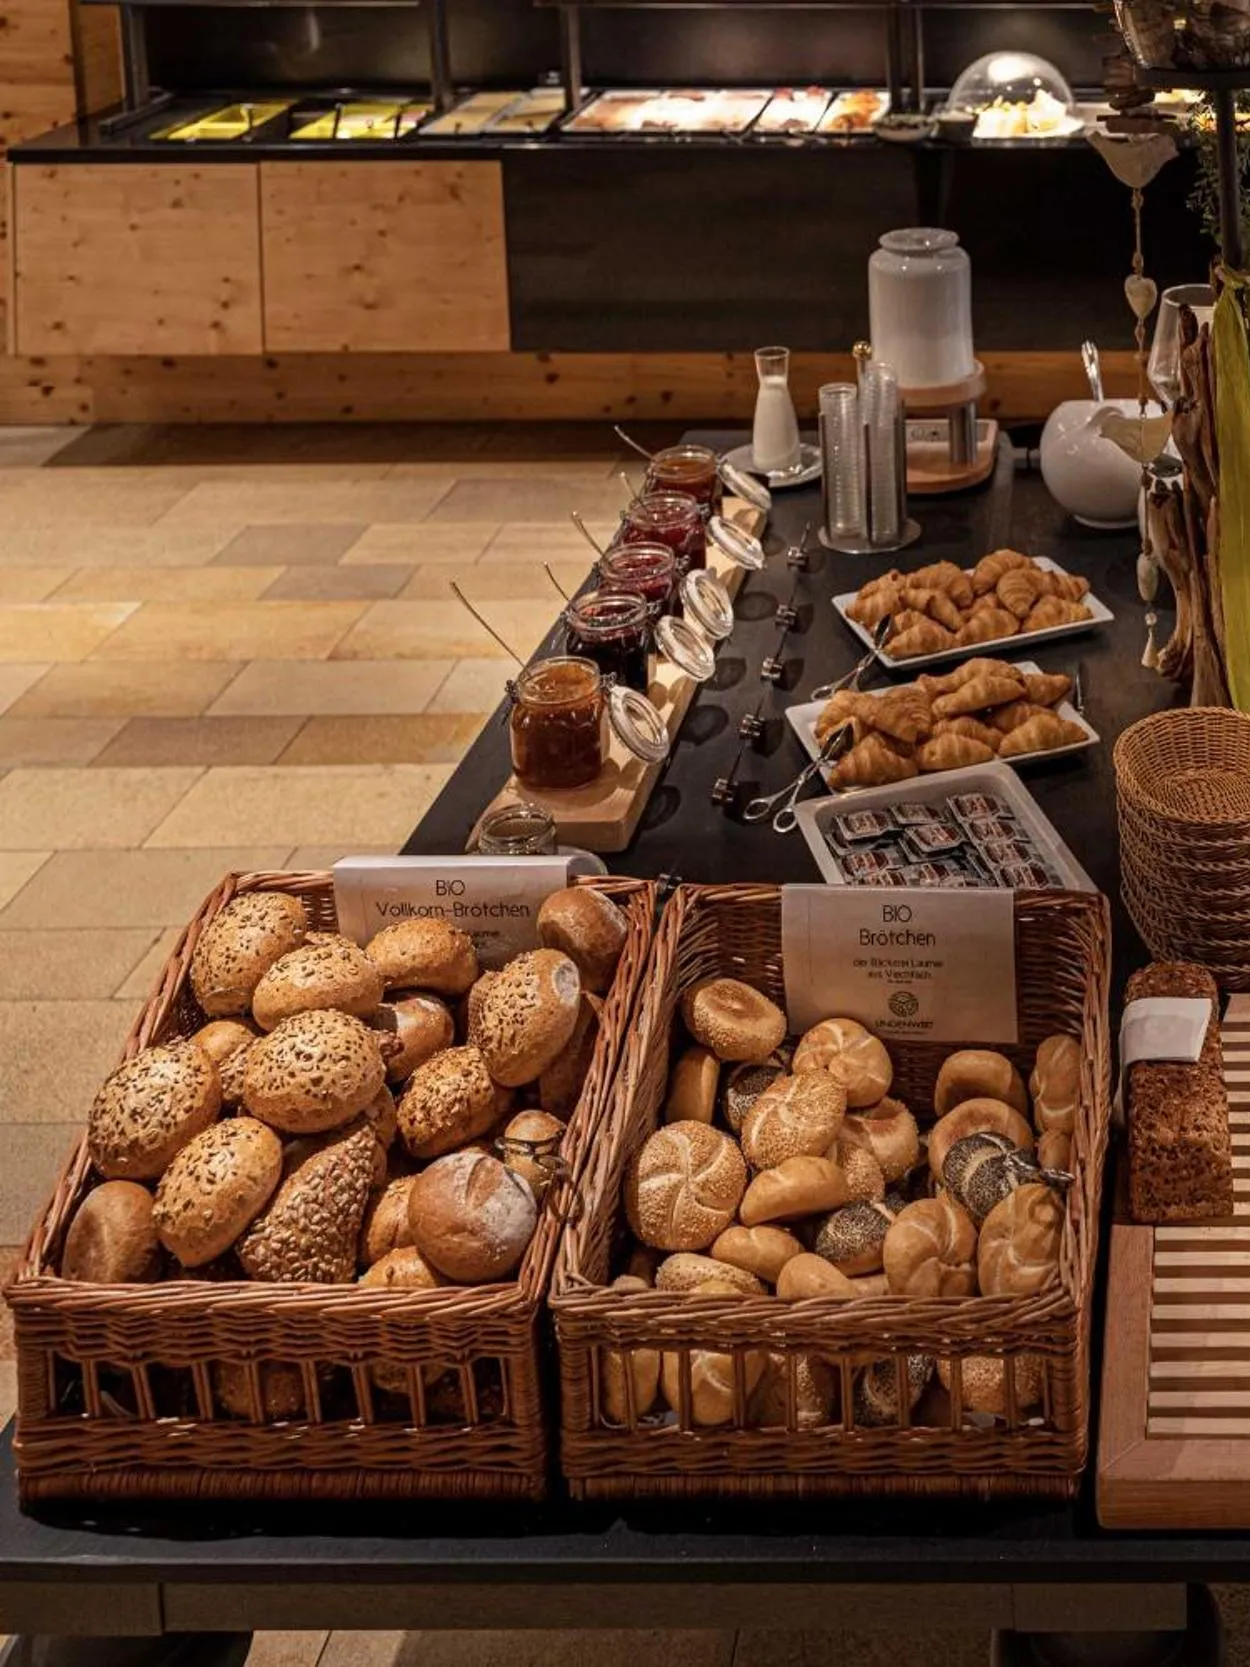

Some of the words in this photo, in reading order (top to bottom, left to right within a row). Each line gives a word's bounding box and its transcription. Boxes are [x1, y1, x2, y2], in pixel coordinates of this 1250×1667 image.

[435, 879, 467, 897] BIO
[376, 901, 530, 918] Vollkorn-Brötchen
[882, 904, 913, 923] BIO
[859, 928, 936, 947] Brötchen
